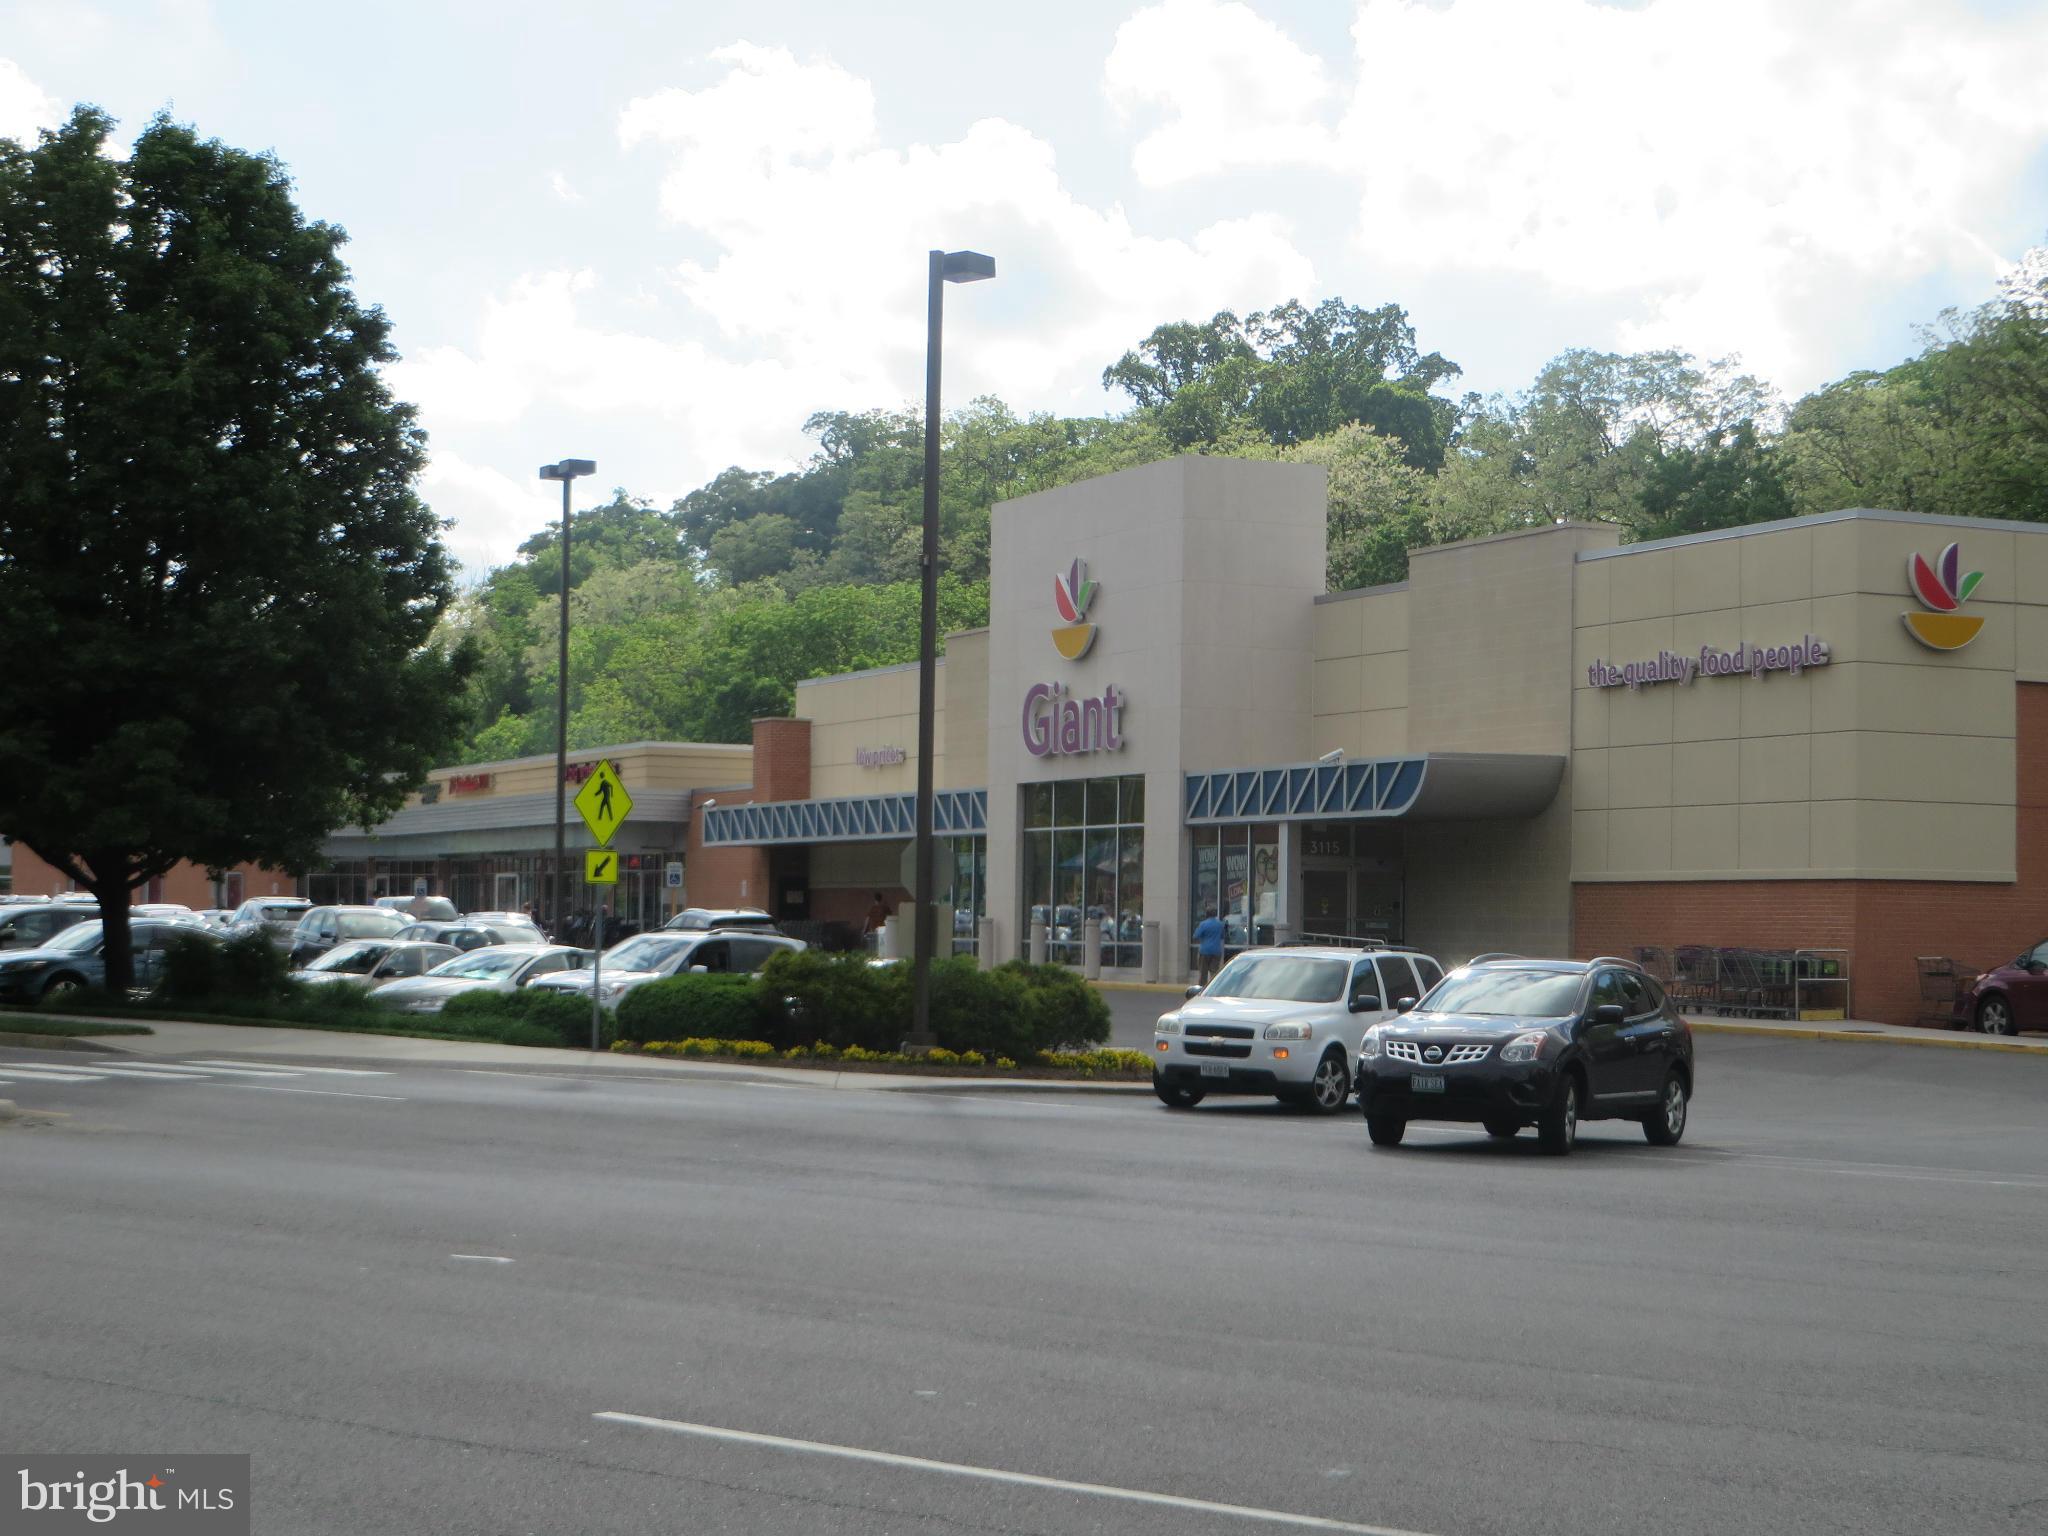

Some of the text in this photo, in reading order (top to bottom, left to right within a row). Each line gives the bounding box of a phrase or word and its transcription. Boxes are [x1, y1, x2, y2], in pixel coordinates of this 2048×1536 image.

[1587, 634, 1823, 690] the quality food people
[1022, 680, 1119, 757] Giant
[1310, 840, 1341, 855] 3115
